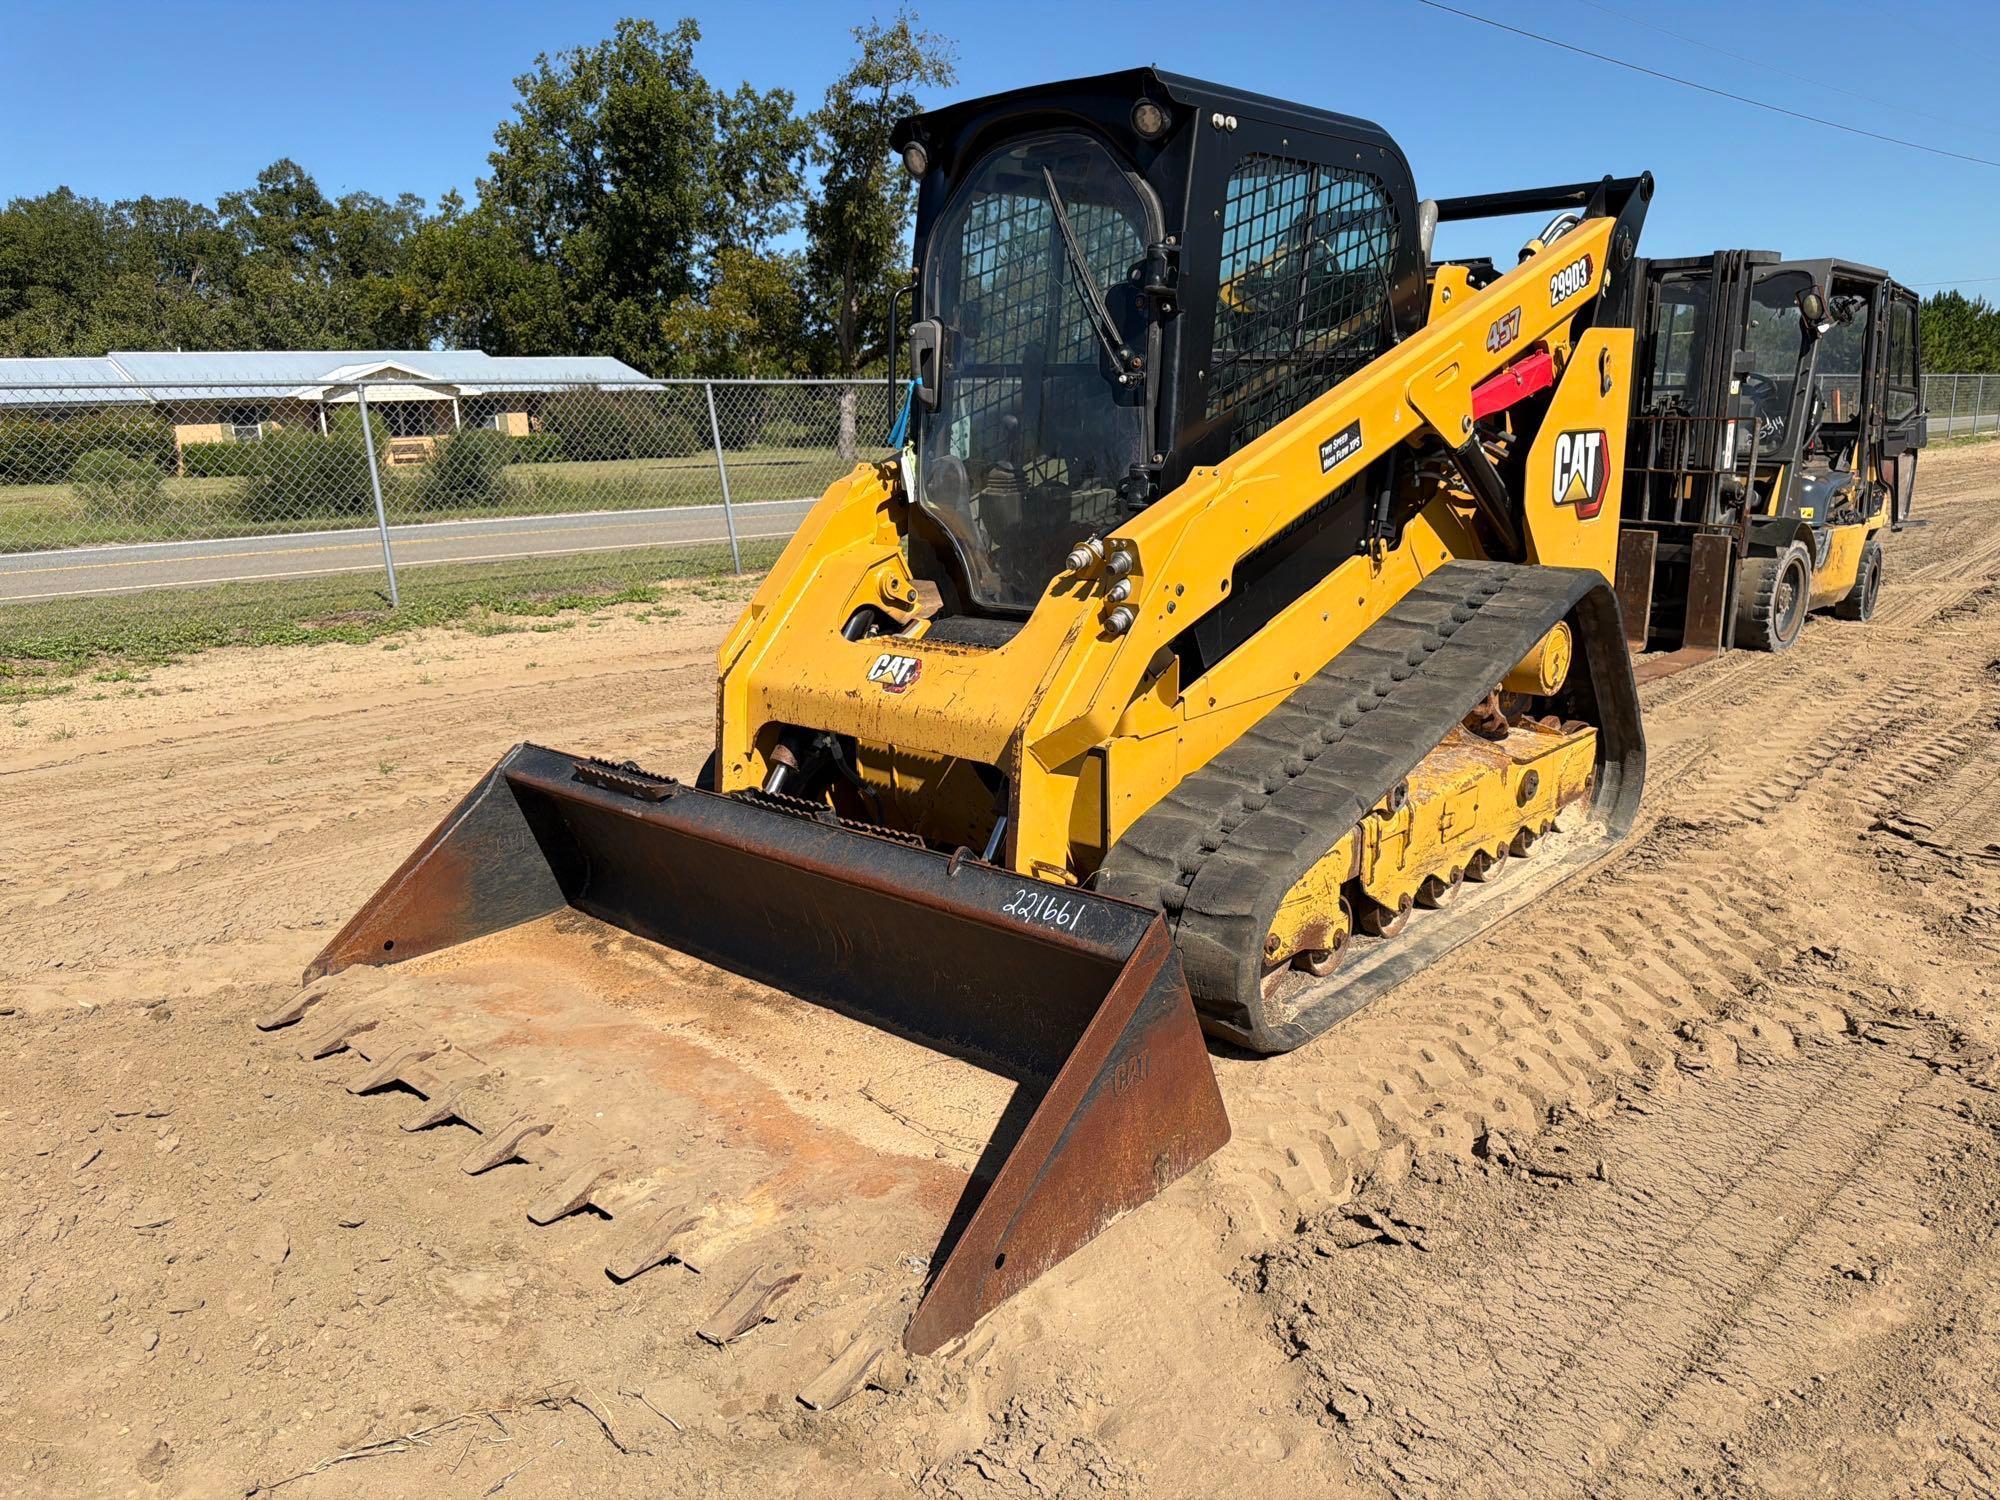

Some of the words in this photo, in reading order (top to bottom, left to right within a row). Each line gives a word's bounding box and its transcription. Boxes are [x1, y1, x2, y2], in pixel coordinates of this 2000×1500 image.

[1550, 258, 1587, 306] 299D3
[1486, 307, 1520, 353] 457
[1553, 432, 1600, 503] CAT
[868, 654, 917, 684] CAT
[1002, 889, 1086, 931] 221661
